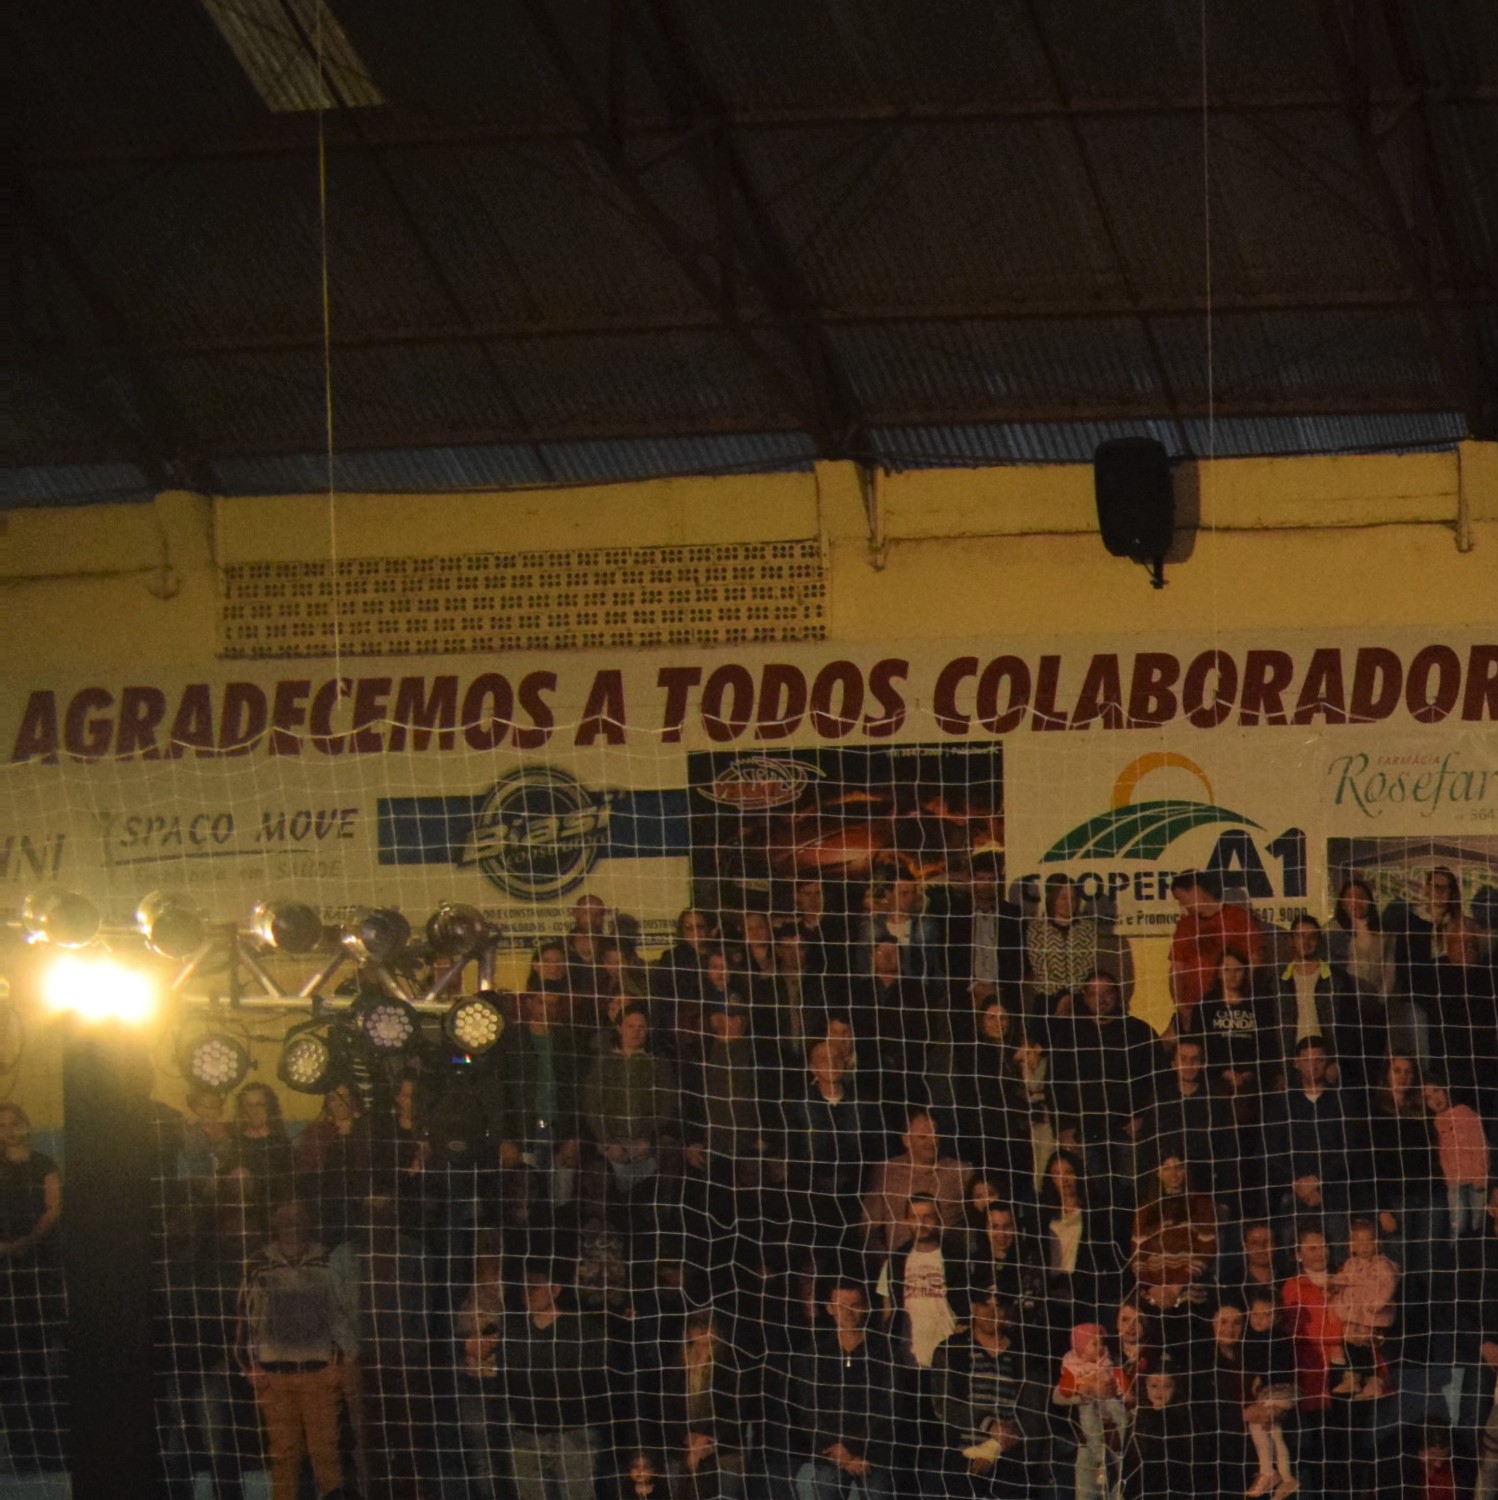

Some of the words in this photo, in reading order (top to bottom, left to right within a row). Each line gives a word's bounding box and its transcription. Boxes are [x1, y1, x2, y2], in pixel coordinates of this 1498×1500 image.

[10, 671, 558, 764] AGRADECEMOS
[574, 670, 627, 747] A
[656, 657, 908, 744] TODOS
[1377, 752, 1441, 766] FARMÁCIA
[255, 808, 358, 843] MOVE
